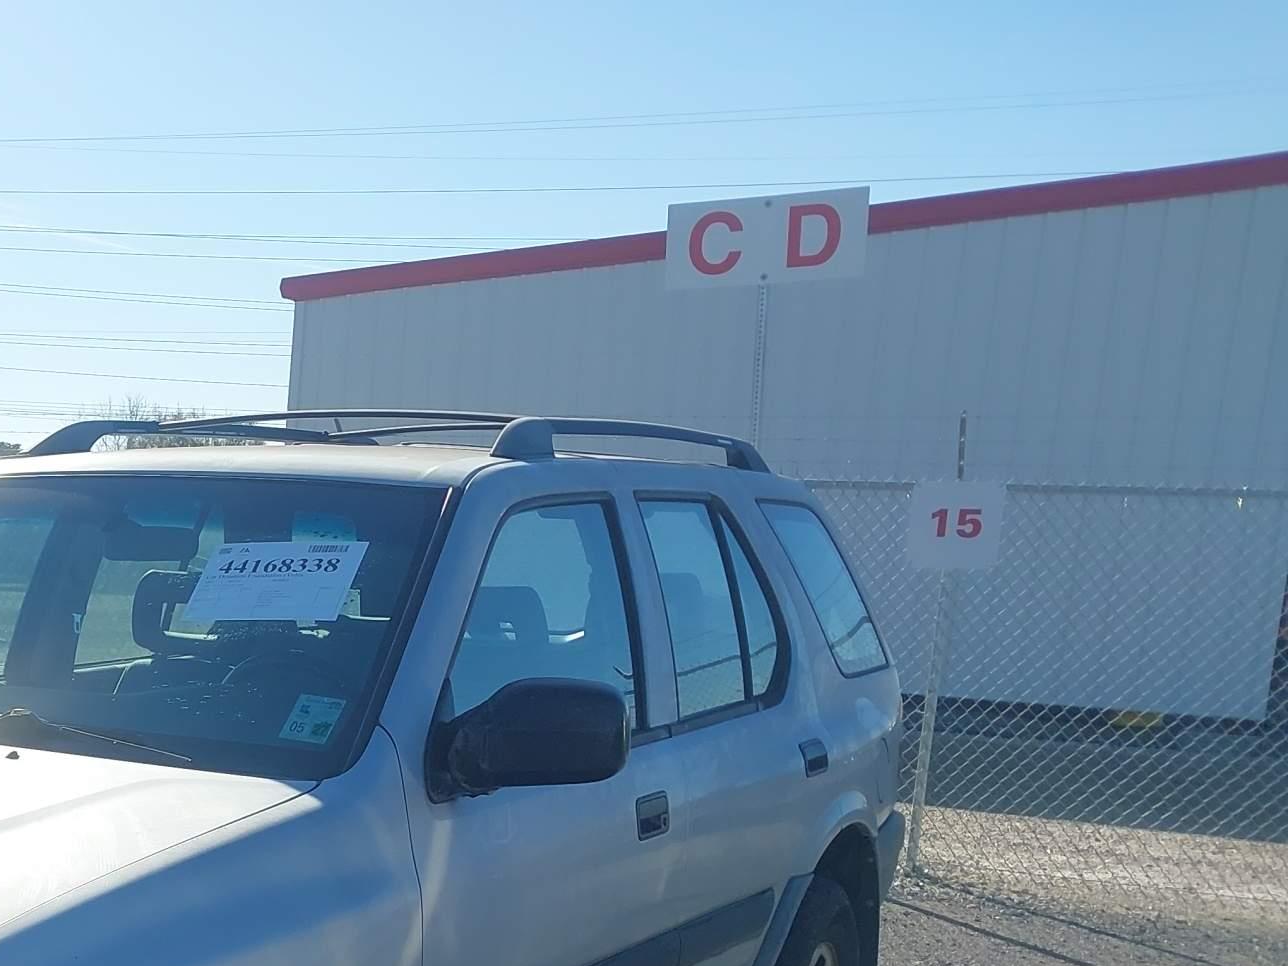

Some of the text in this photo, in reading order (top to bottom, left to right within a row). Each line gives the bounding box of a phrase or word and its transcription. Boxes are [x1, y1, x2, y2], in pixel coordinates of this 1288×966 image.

[688, 203, 842, 275] C D
[930, 507, 983, 539] 15
[218, 557, 341, 574] 44168338
